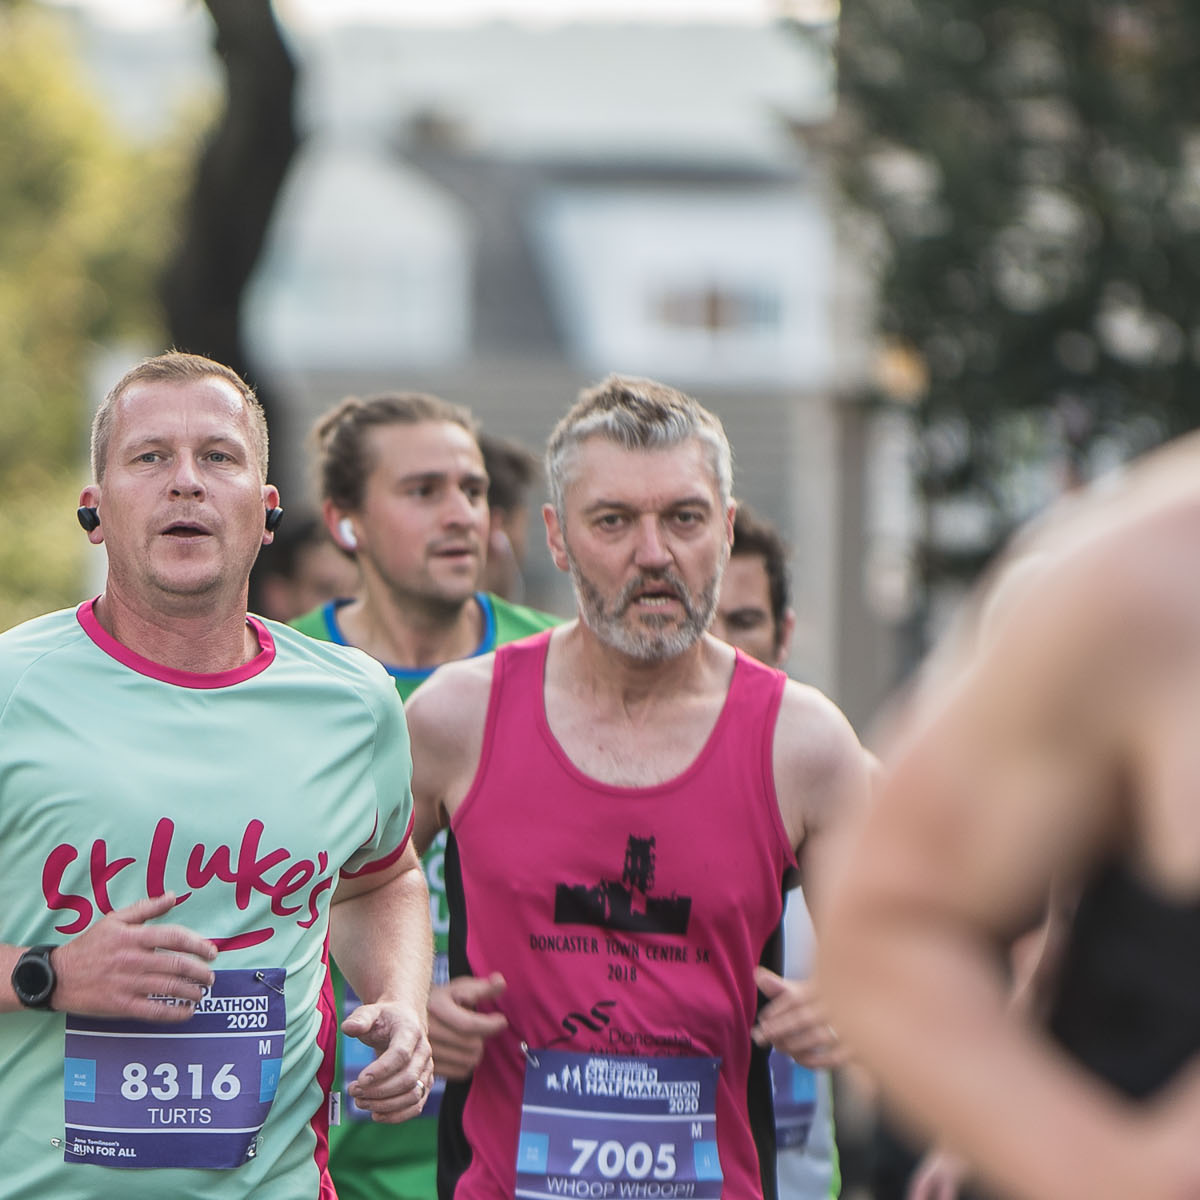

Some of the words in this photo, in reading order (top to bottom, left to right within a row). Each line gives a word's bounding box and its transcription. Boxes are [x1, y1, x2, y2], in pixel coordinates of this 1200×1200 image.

[529, 933, 599, 954] DONCASTER
[605, 937, 640, 960] TOWN
[645, 943, 689, 964] CENTRE
[607, 964, 638, 983] 2018
[227, 1013, 268, 1029] 2020
[258, 1039, 272, 1056] M
[120, 1062, 241, 1101] 8316
[586, 1081, 622, 1096] HALF
[625, 1082, 700, 1098] MARATHON
[668, 1099, 699, 1114] 2020
[147, 1107, 212, 1125] TURTS
[691, 1121, 703, 1139] M
[73, 1143, 95, 1155] RUN
[96, 1146, 116, 1157] FOR
[117, 1147, 137, 1158] ALL
[569, 1138, 676, 1180] 7005
[546, 1176, 615, 1198] WHOOP
[619, 1181, 695, 1199] WHOOP!!
